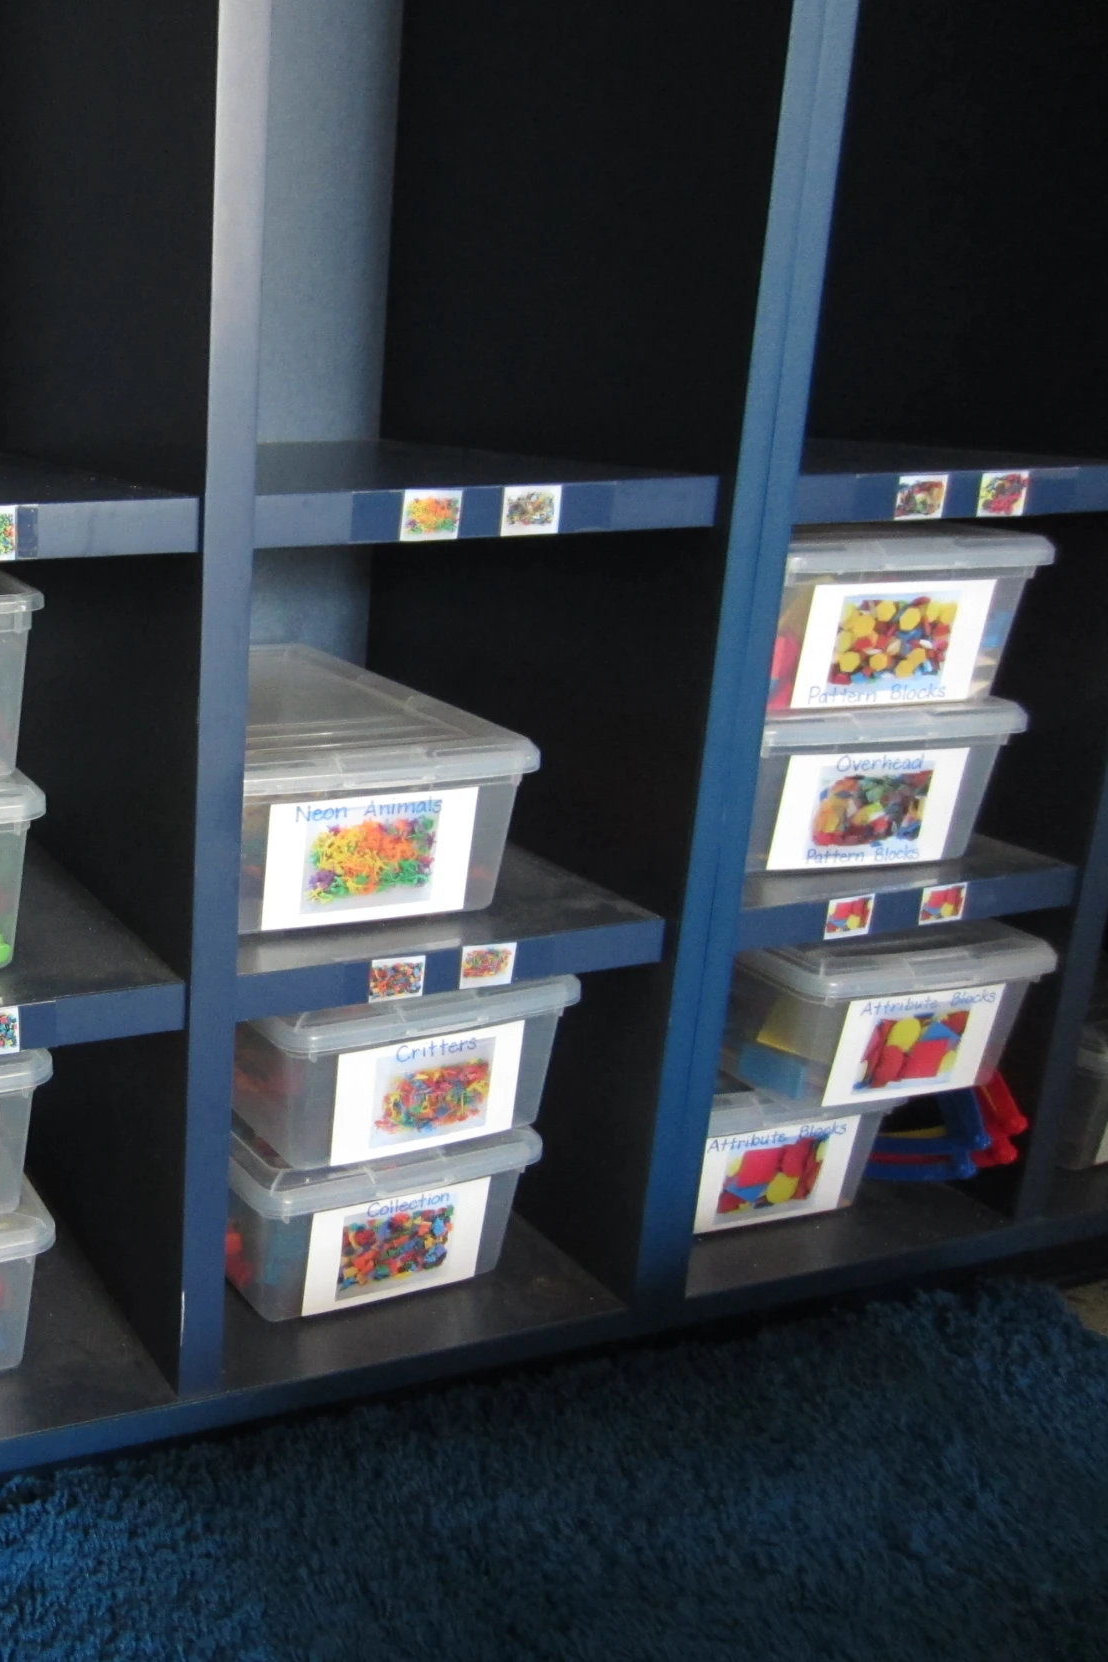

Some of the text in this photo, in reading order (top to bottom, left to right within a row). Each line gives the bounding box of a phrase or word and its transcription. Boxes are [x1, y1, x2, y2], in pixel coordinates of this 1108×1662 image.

[806, 681, 946, 707] Pattern Blocks
[836, 754, 924, 773] Overhead
[295, 797, 443, 823] Neon Animals
[806, 845, 920, 865] Pattern Blocks
[861, 990, 996, 1017] Attribute Blocks
[395, 1037, 477, 1063] Critters
[707, 1120, 848, 1154] Attribute Blocks
[367, 1190, 450, 1218] Collection
